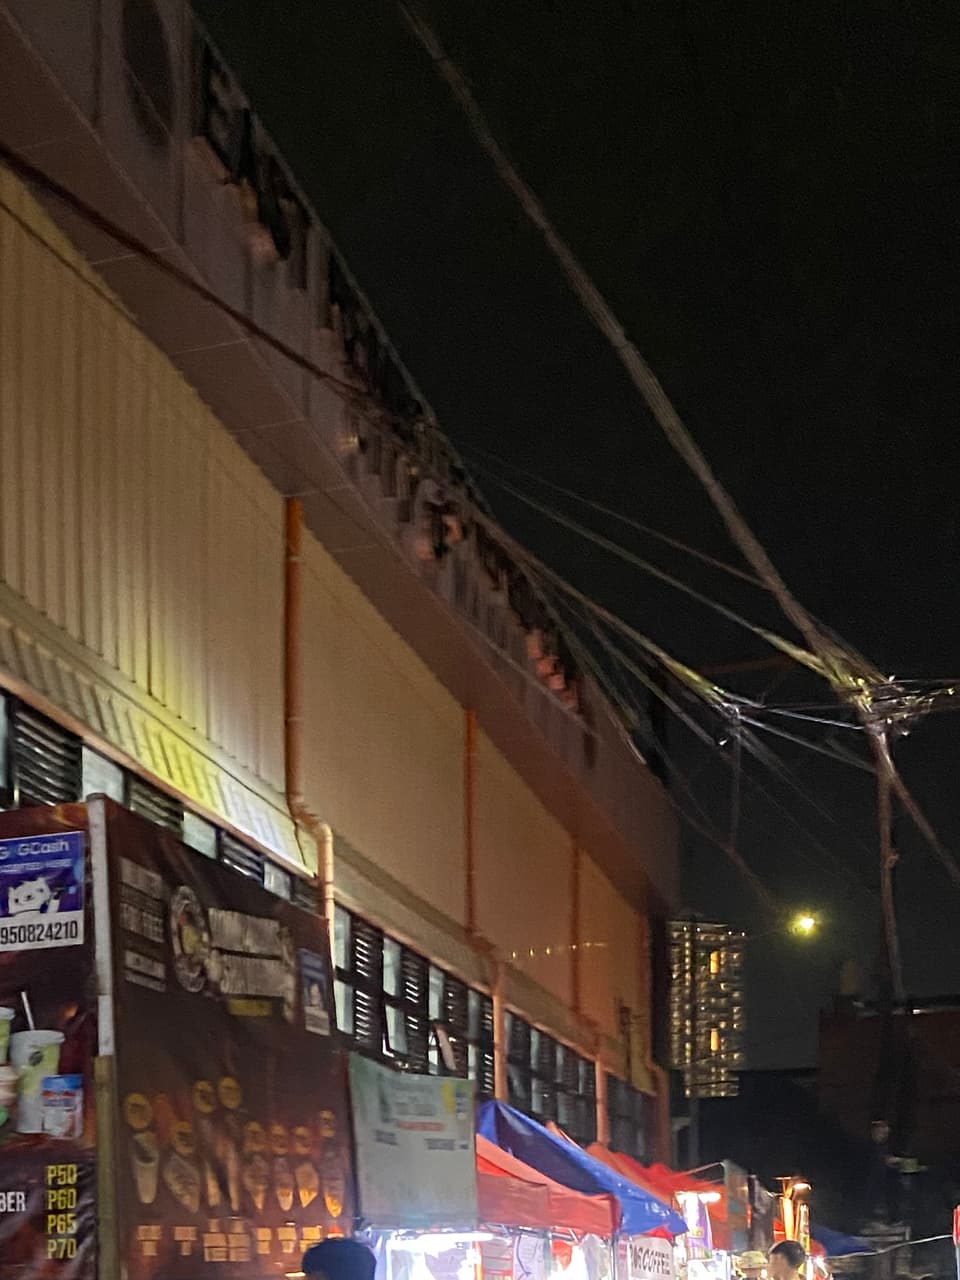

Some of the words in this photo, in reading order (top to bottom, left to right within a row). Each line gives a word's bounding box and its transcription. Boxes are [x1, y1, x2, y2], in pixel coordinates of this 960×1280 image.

[47, 1164, 77, 1185] P50
[47, 1189, 76, 1209] P60
[48, 1214, 77, 1234] P65
[48, 1239, 76, 1259] P70
